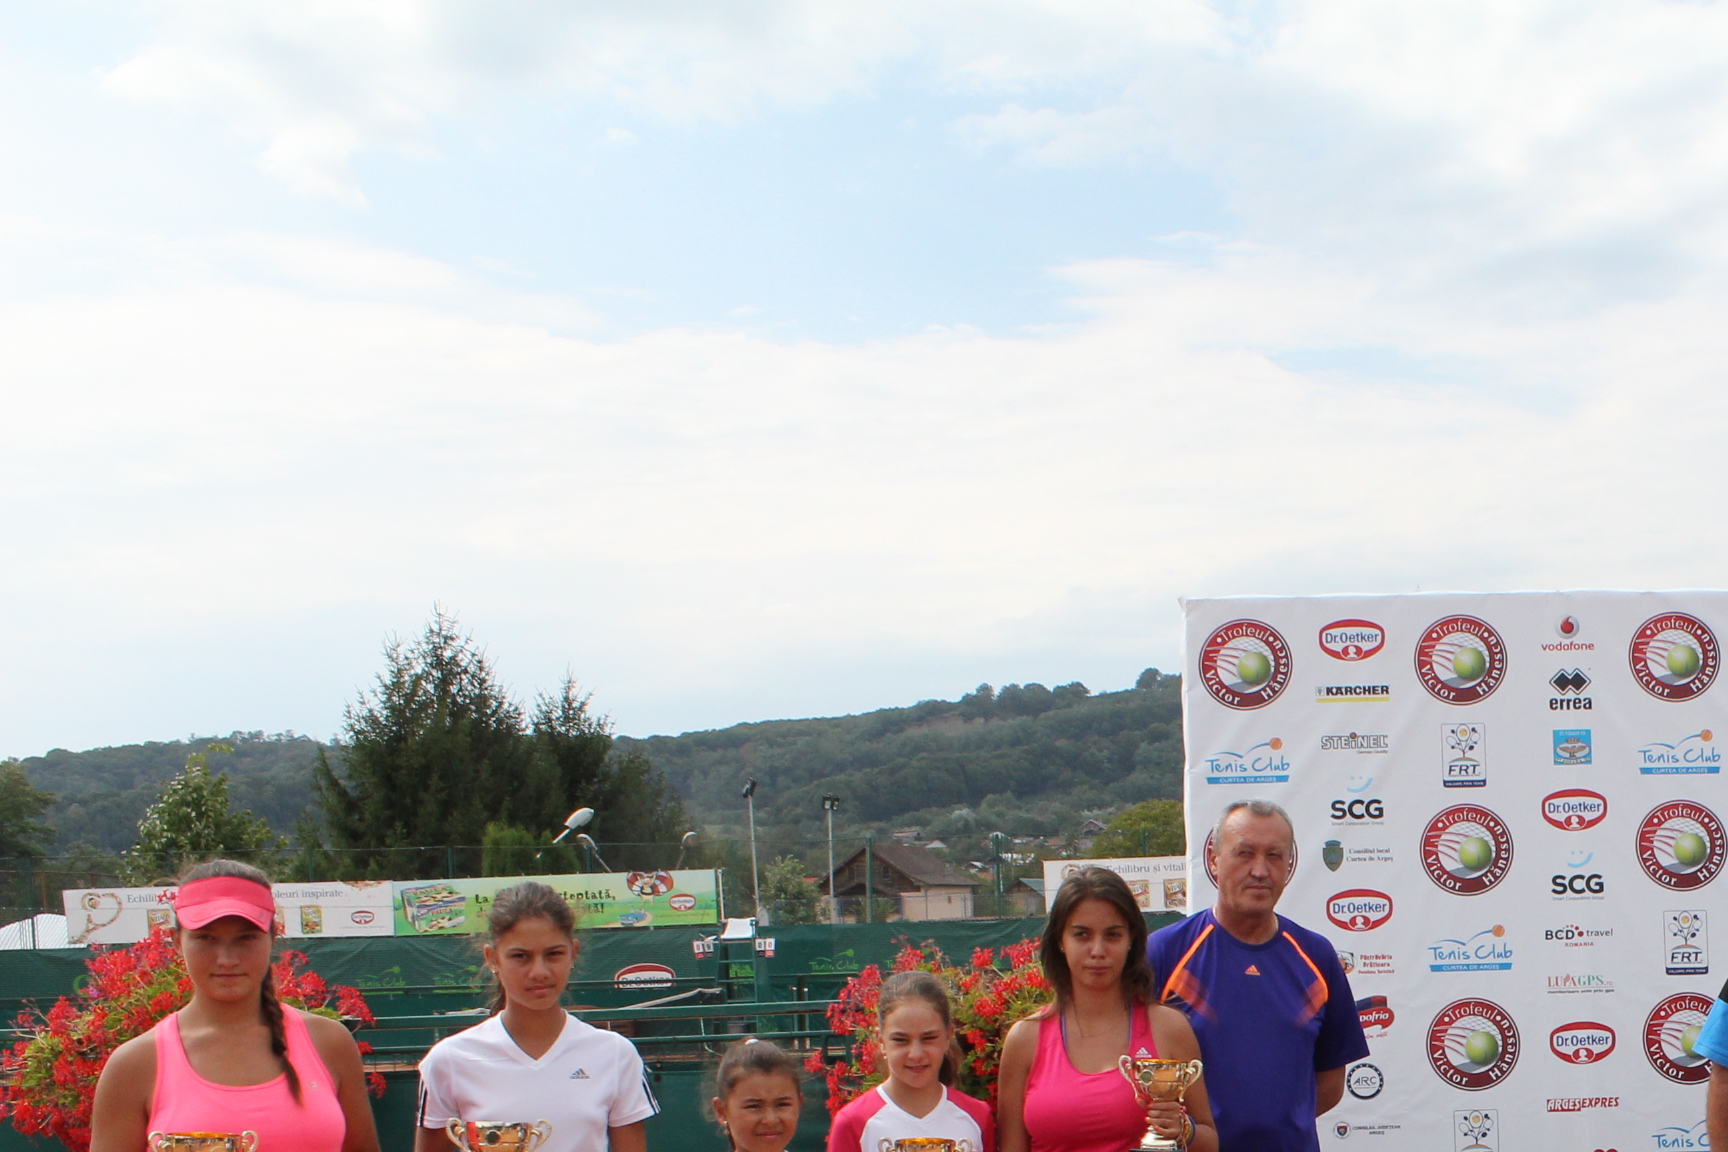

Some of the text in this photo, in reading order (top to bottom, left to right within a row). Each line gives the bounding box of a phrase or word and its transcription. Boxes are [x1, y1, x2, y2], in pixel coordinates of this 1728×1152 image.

[1220, 623, 1270, 642] Trofeul
[1435, 619, 1485, 637] Trofeul
[1649, 616, 1697, 634] Trofeul
[1541, 642, 1594, 651] vodafone
[1205, 670, 1241, 705] Victor
[1421, 665, 1456, 700] Victor
[1635, 661, 1670, 696] Victor
[1550, 697, 1592, 710] errea
[1638, 747, 1721, 763] Tenis Club
[1206, 756, 1290, 773] Tenis Club
[1448, 765, 1480, 776] FRT
[1331, 799, 1384, 820] SCG
[1442, 808, 1489, 826] Trofeul
[1655, 804, 1705, 822] Trofeul
[1164, 863, 1186, 871] vitali
[1426, 855, 1462, 891] Victor
[1642, 850, 1678, 886] Victor
[1551, 874, 1604, 895] SCG
[274, 886, 343, 902] oleuri inspirate
[475, 894, 488, 904] La
[1545, 928, 1613, 940] BCD travel
[1428, 942, 1513, 961] Tenis Club
[1671, 952, 1703, 963] FRT
[1359, 1011, 1389, 1023] pofrio
[1448, 1002, 1497, 1021] Trofeul
[1433, 1049, 1469, 1085] Victor
[1649, 1043, 1685, 1079] Victor
[1353, 1076, 1377, 1086] ARC
[1652, 1134, 1694, 1148] Tenis
